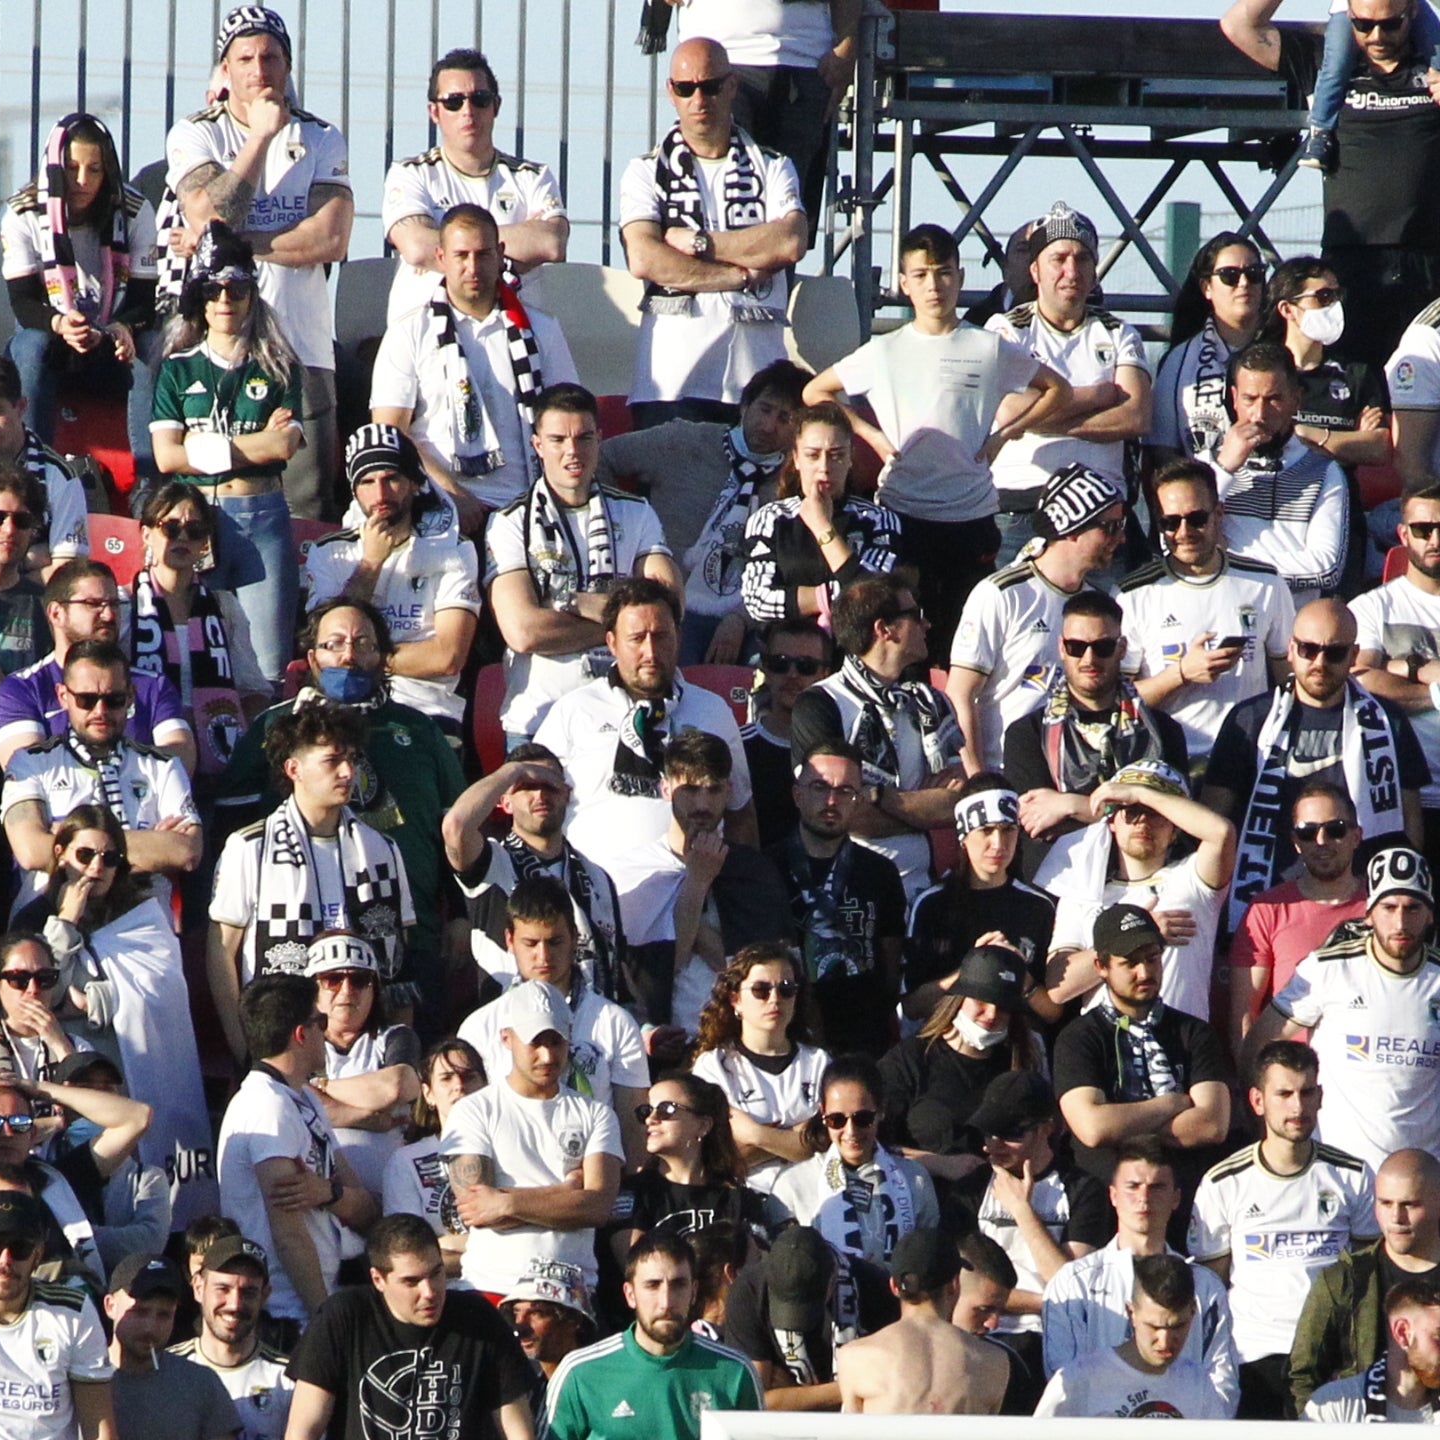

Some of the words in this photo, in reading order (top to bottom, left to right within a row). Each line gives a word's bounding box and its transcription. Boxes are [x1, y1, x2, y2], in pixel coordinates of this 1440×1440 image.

[107, 540, 122, 551] 55
[732, 690, 747, 700] 58
[1356, 692, 1402, 816] ESTA
[1375, 1054, 1440, 1071] SEGUROS
[1275, 1230, 1338, 1247] REALE
[1275, 1244, 1341, 1262] SEGUROS
